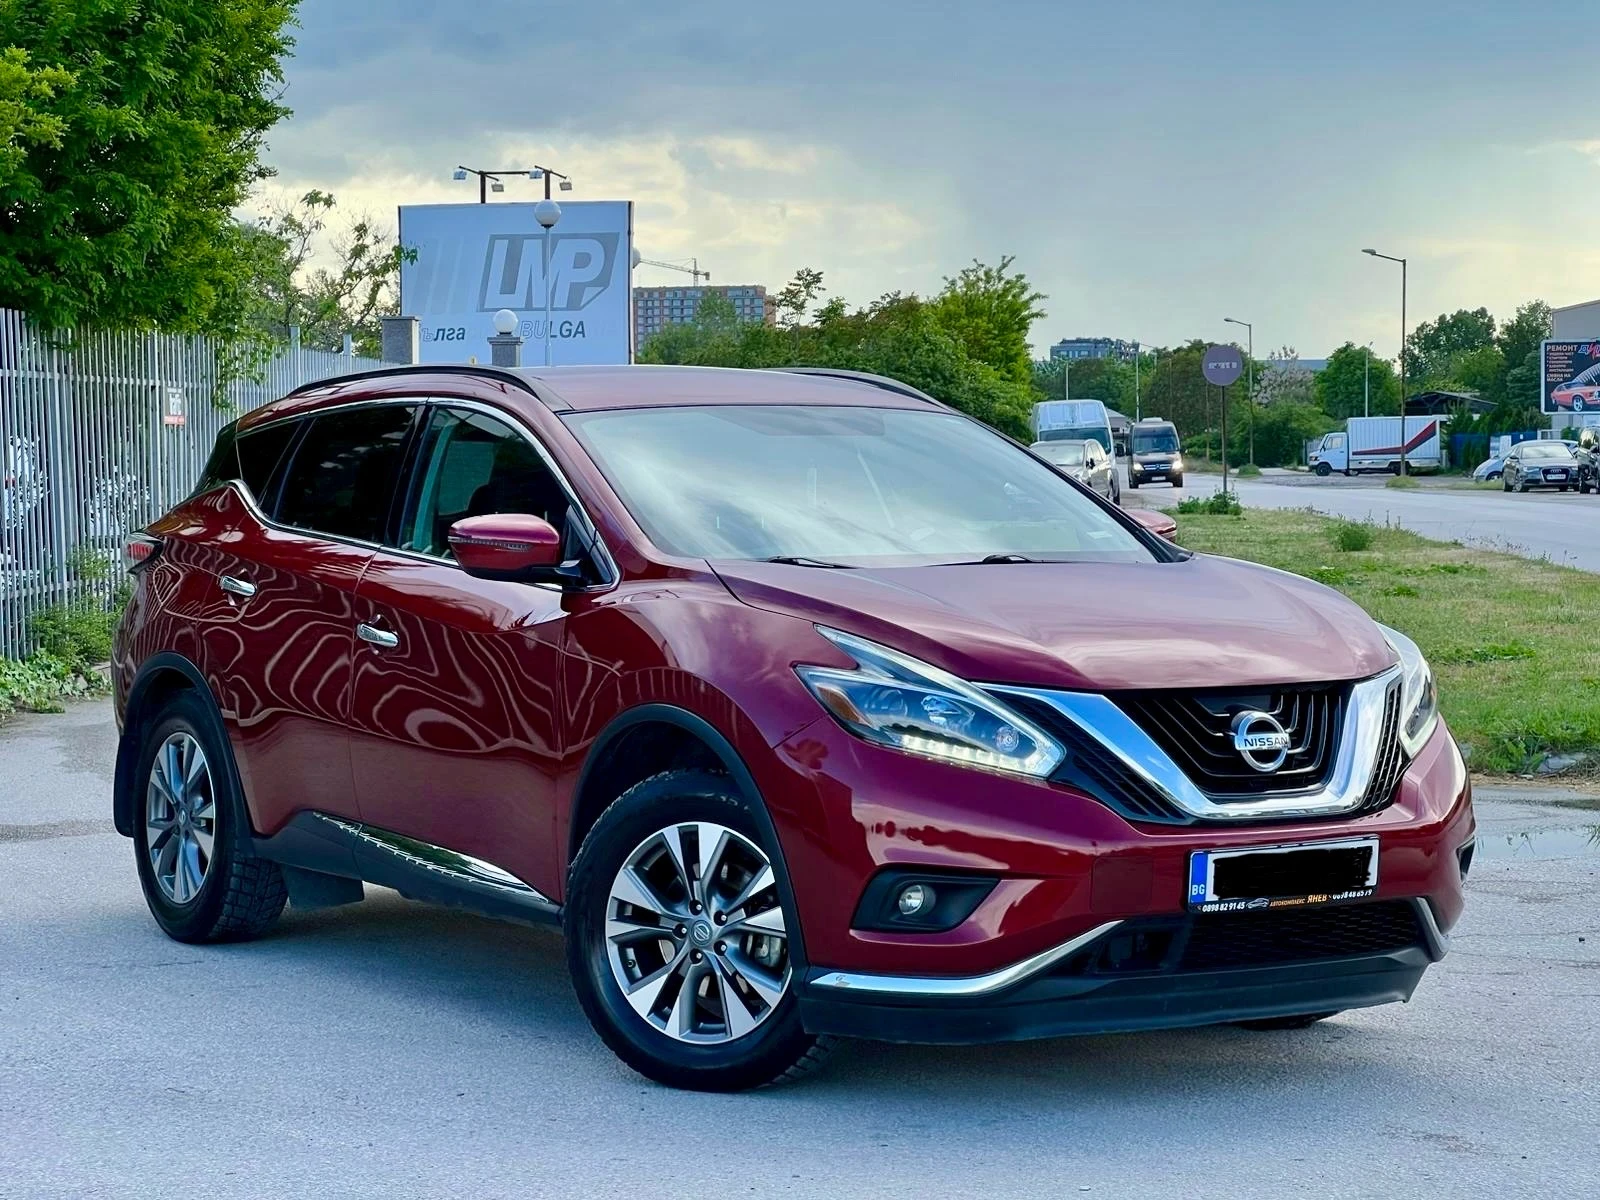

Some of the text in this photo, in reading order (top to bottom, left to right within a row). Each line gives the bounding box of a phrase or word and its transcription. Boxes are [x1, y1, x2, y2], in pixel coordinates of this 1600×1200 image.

[483, 238, 605, 309] LMP
[420, 326, 466, 342] ълга
[520, 320, 586, 339] BULGA
[1243, 736, 1288, 747] NISSAN
[1191, 884, 1206, 896] BG
[1307, 894, 1327, 904] ЯНЕВ
